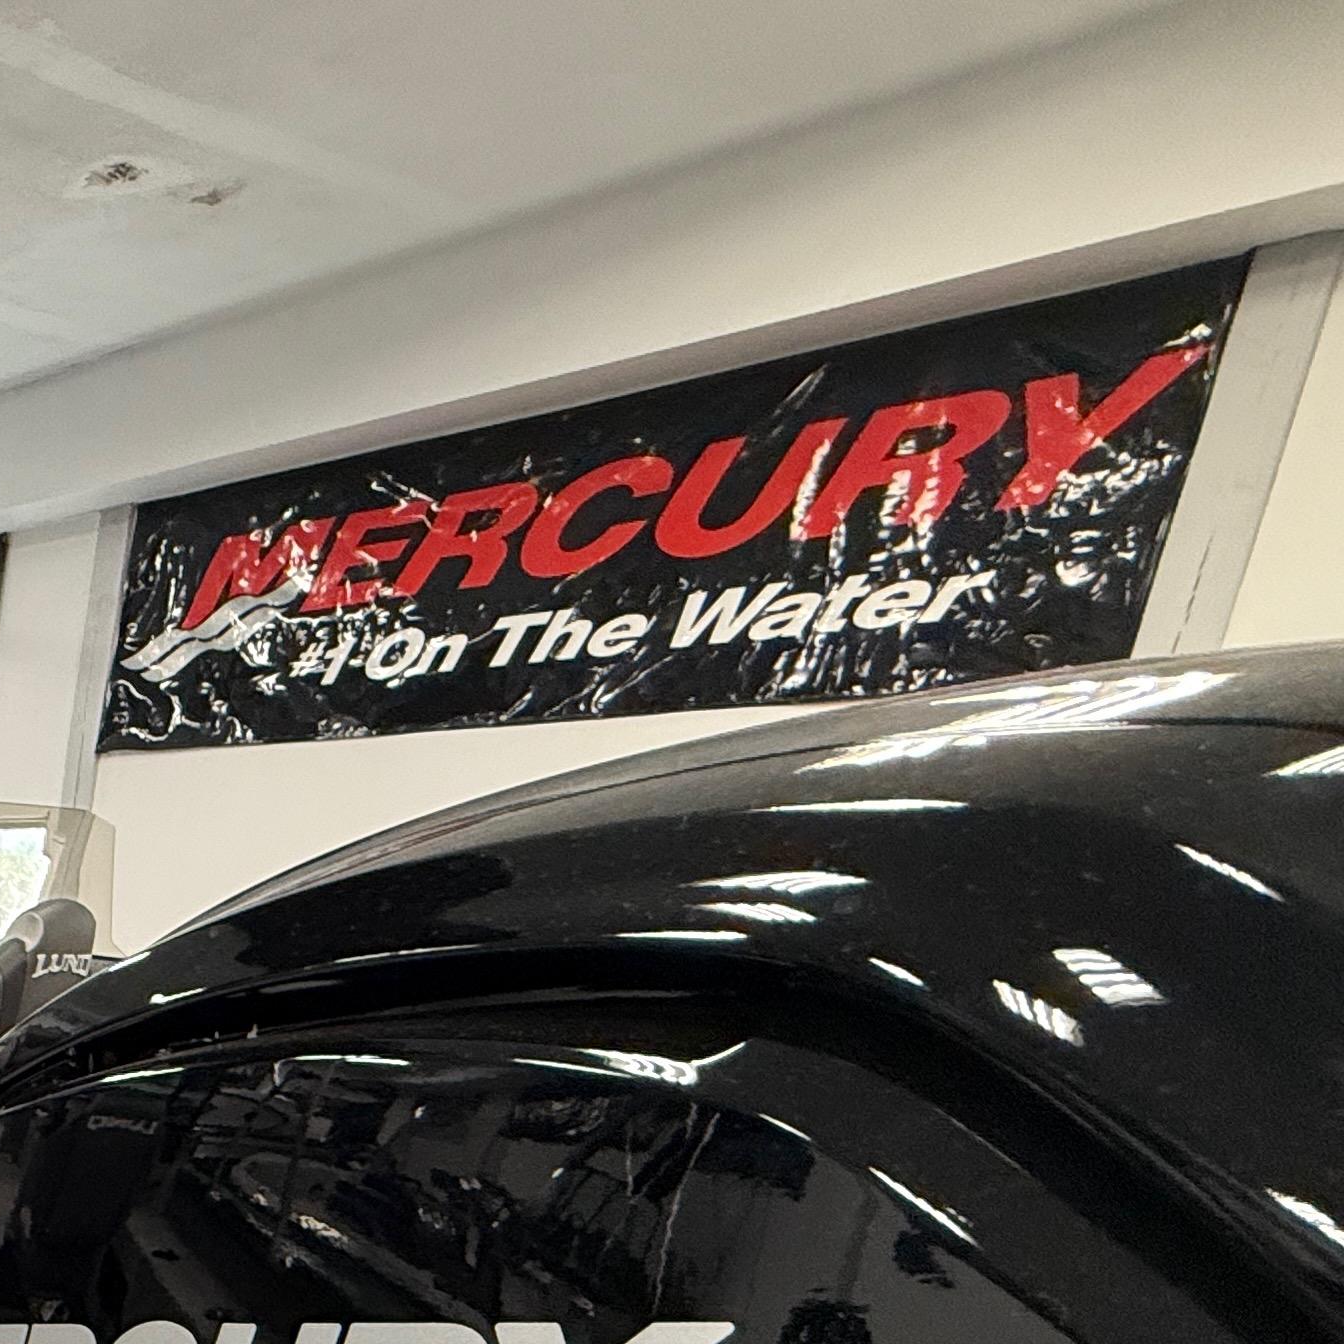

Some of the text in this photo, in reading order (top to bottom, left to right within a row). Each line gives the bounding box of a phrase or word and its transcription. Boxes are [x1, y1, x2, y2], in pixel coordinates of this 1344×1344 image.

[180, 340, 1212, 630] MERCURY
[364, 628, 468, 682] On
[489, 609, 648, 668] The
[670, 569, 997, 650] Water
[32, 953, 92, 978] LUND
